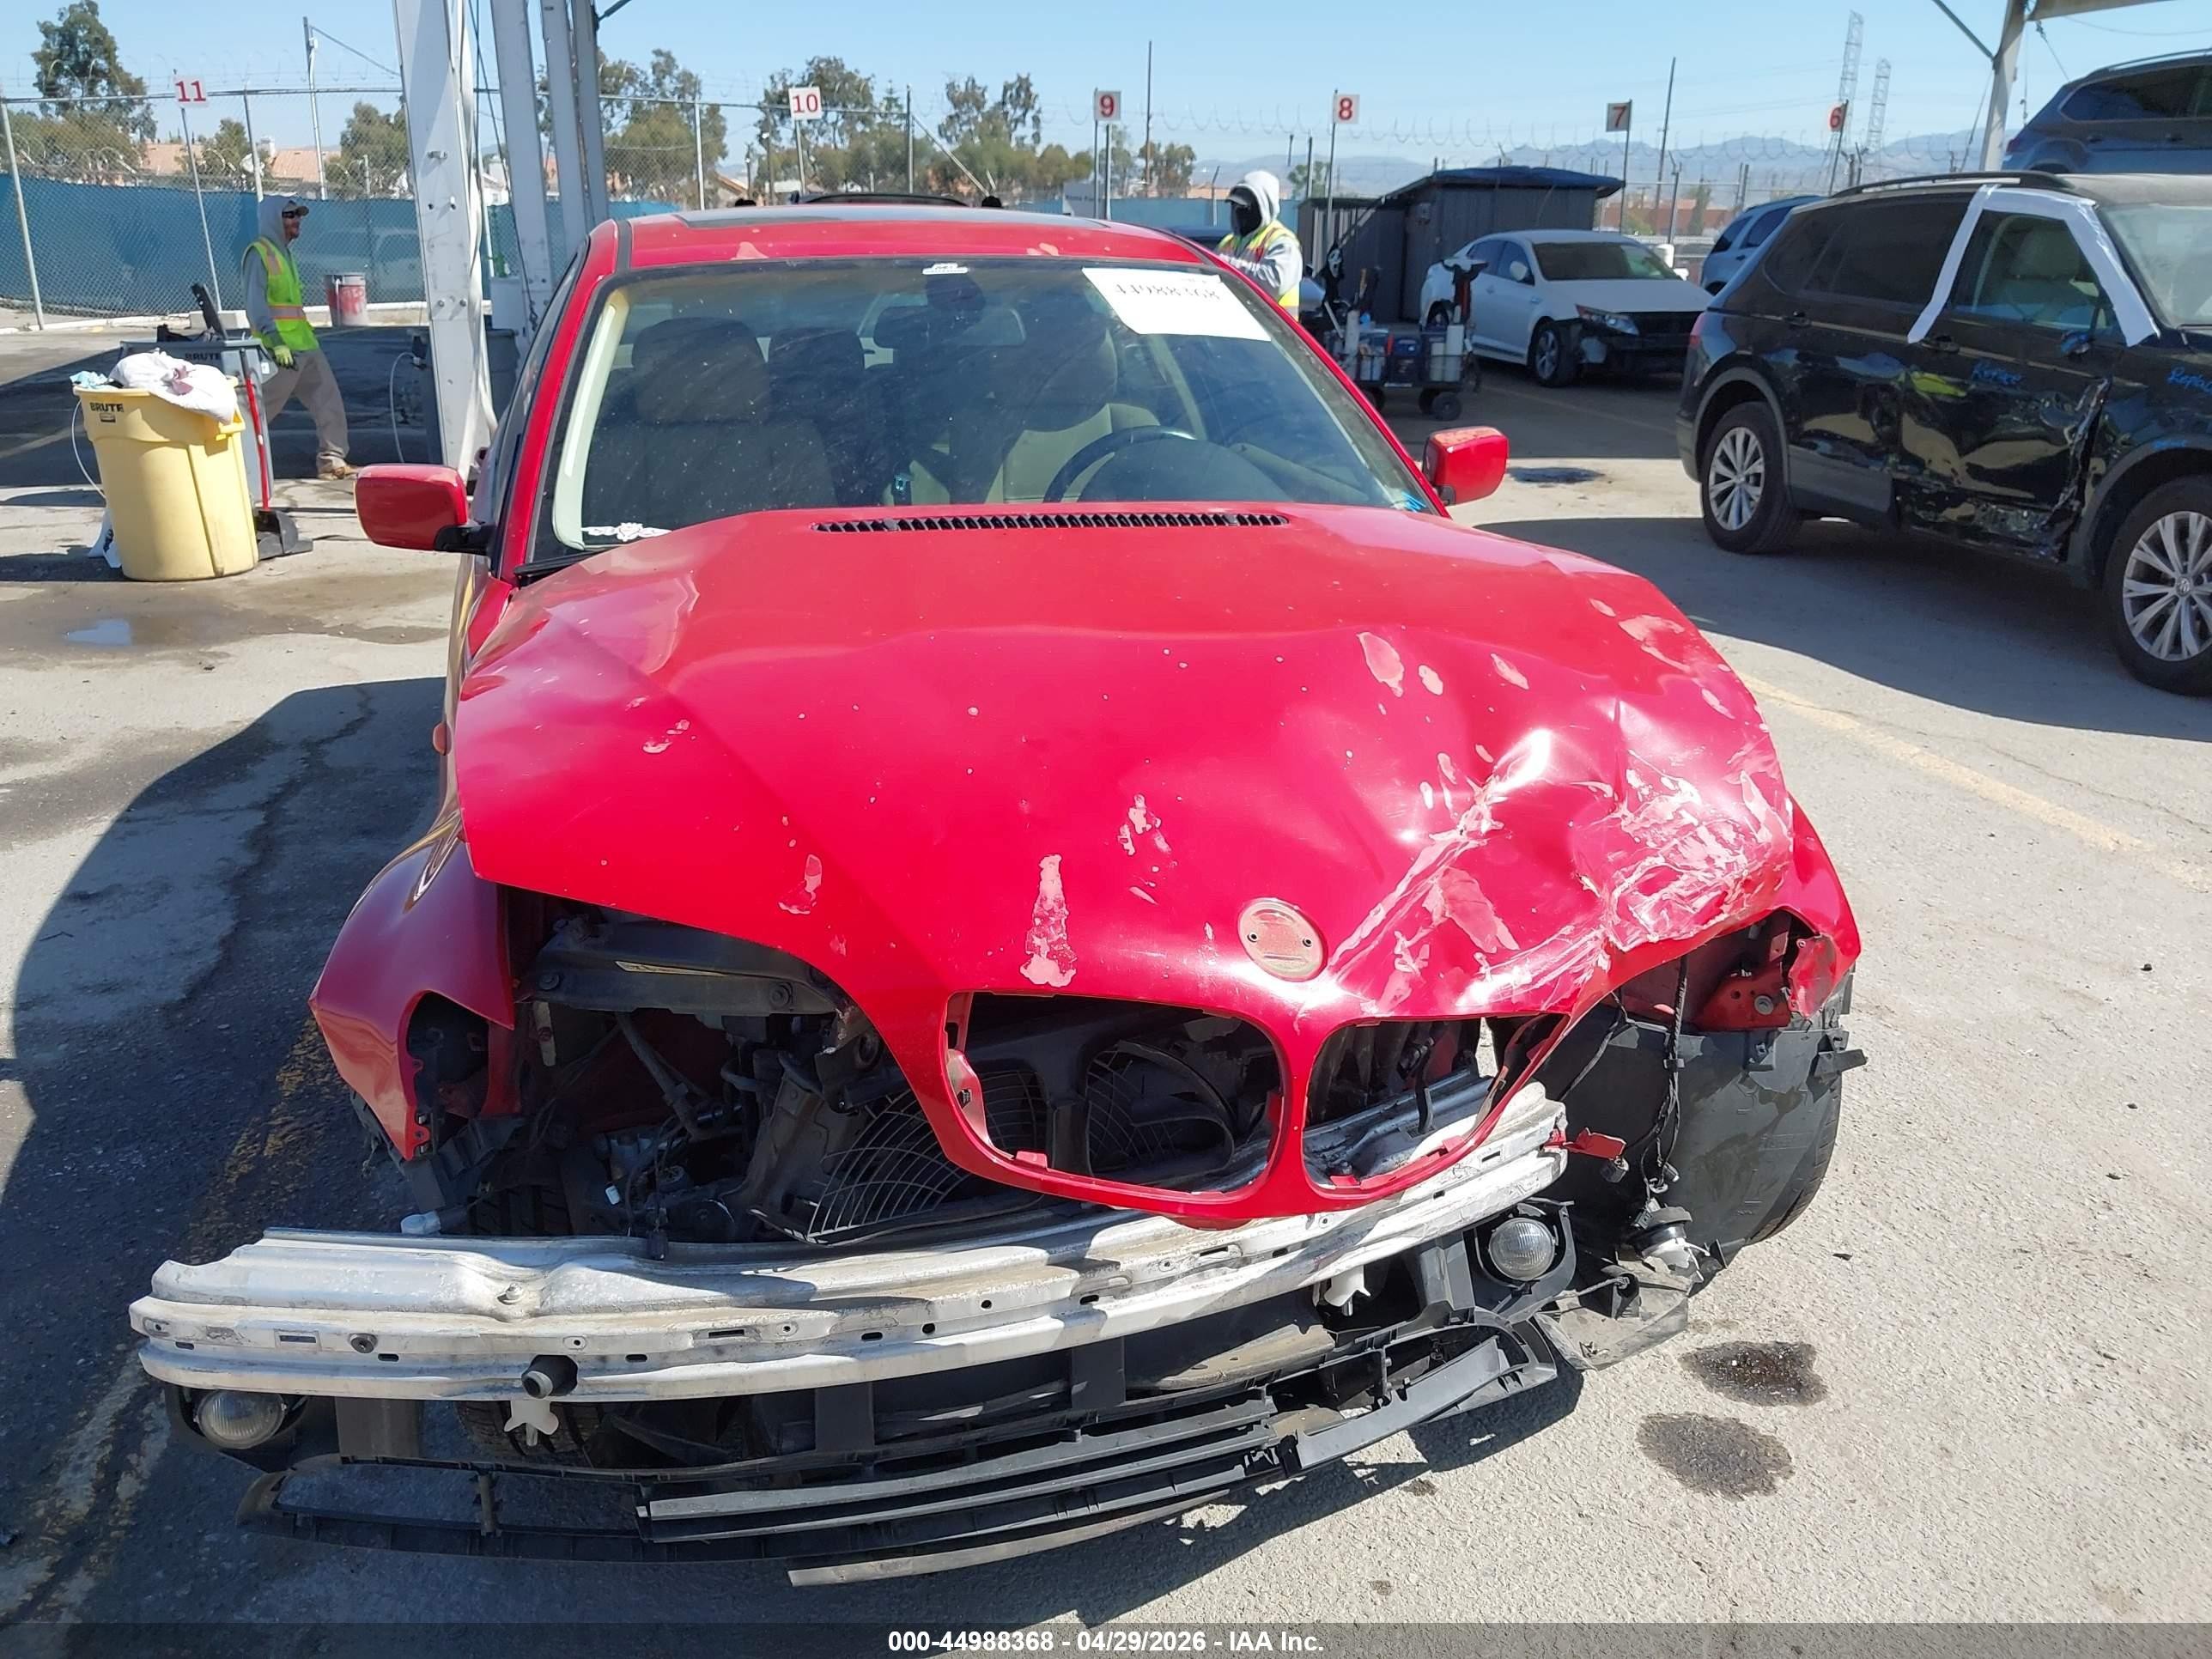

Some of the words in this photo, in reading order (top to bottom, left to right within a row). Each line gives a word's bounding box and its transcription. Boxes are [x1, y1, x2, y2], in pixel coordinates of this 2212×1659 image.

[174, 80, 207, 102] 11
[792, 94, 818, 113] 10
[1100, 94, 1115, 118] 9
[1339, 97, 1353, 120] 8
[1612, 105, 1628, 128] 7
[1830, 106, 1842, 129] 6
[89, 402, 125, 413] BRUTE
